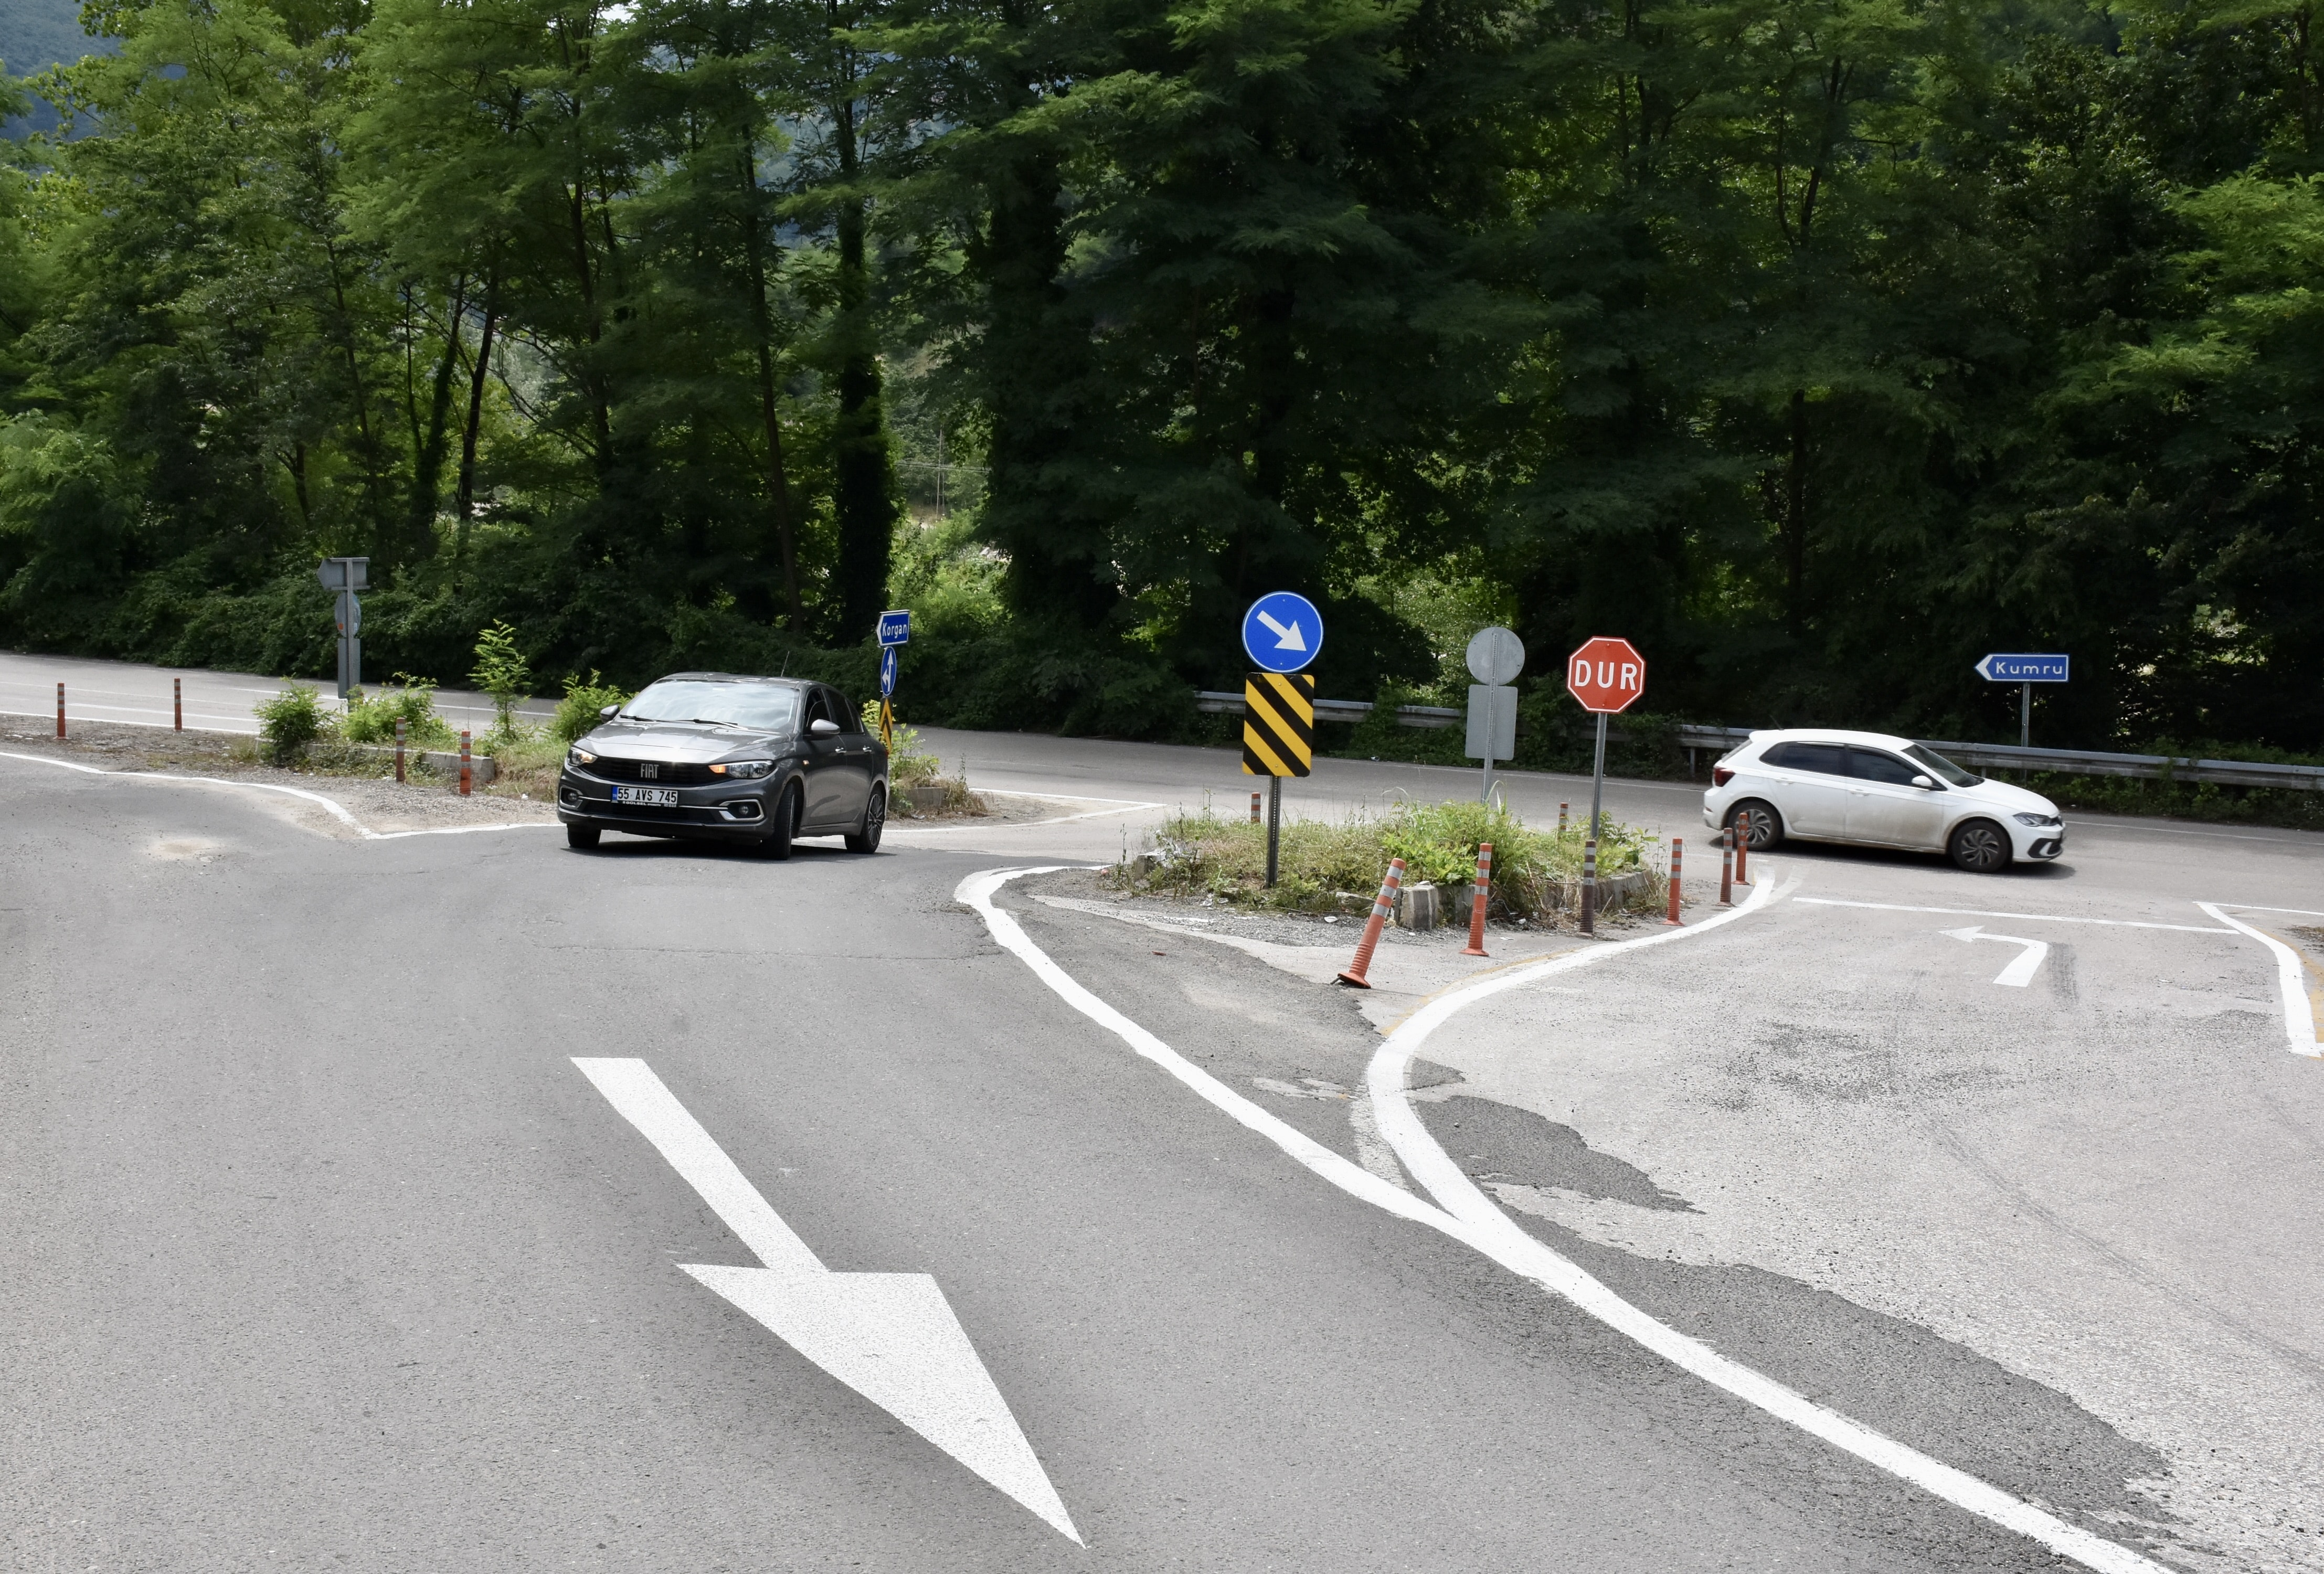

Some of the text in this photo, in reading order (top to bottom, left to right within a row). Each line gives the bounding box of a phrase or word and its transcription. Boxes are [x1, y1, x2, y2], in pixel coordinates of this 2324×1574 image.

[882, 622, 907, 639] Korgan
[1575, 660, 1637, 690] DUR
[1996, 662, 2062, 674] Kumru
[640, 763, 659, 779] FIAT
[618, 788, 676, 803] 55 AVS 745
